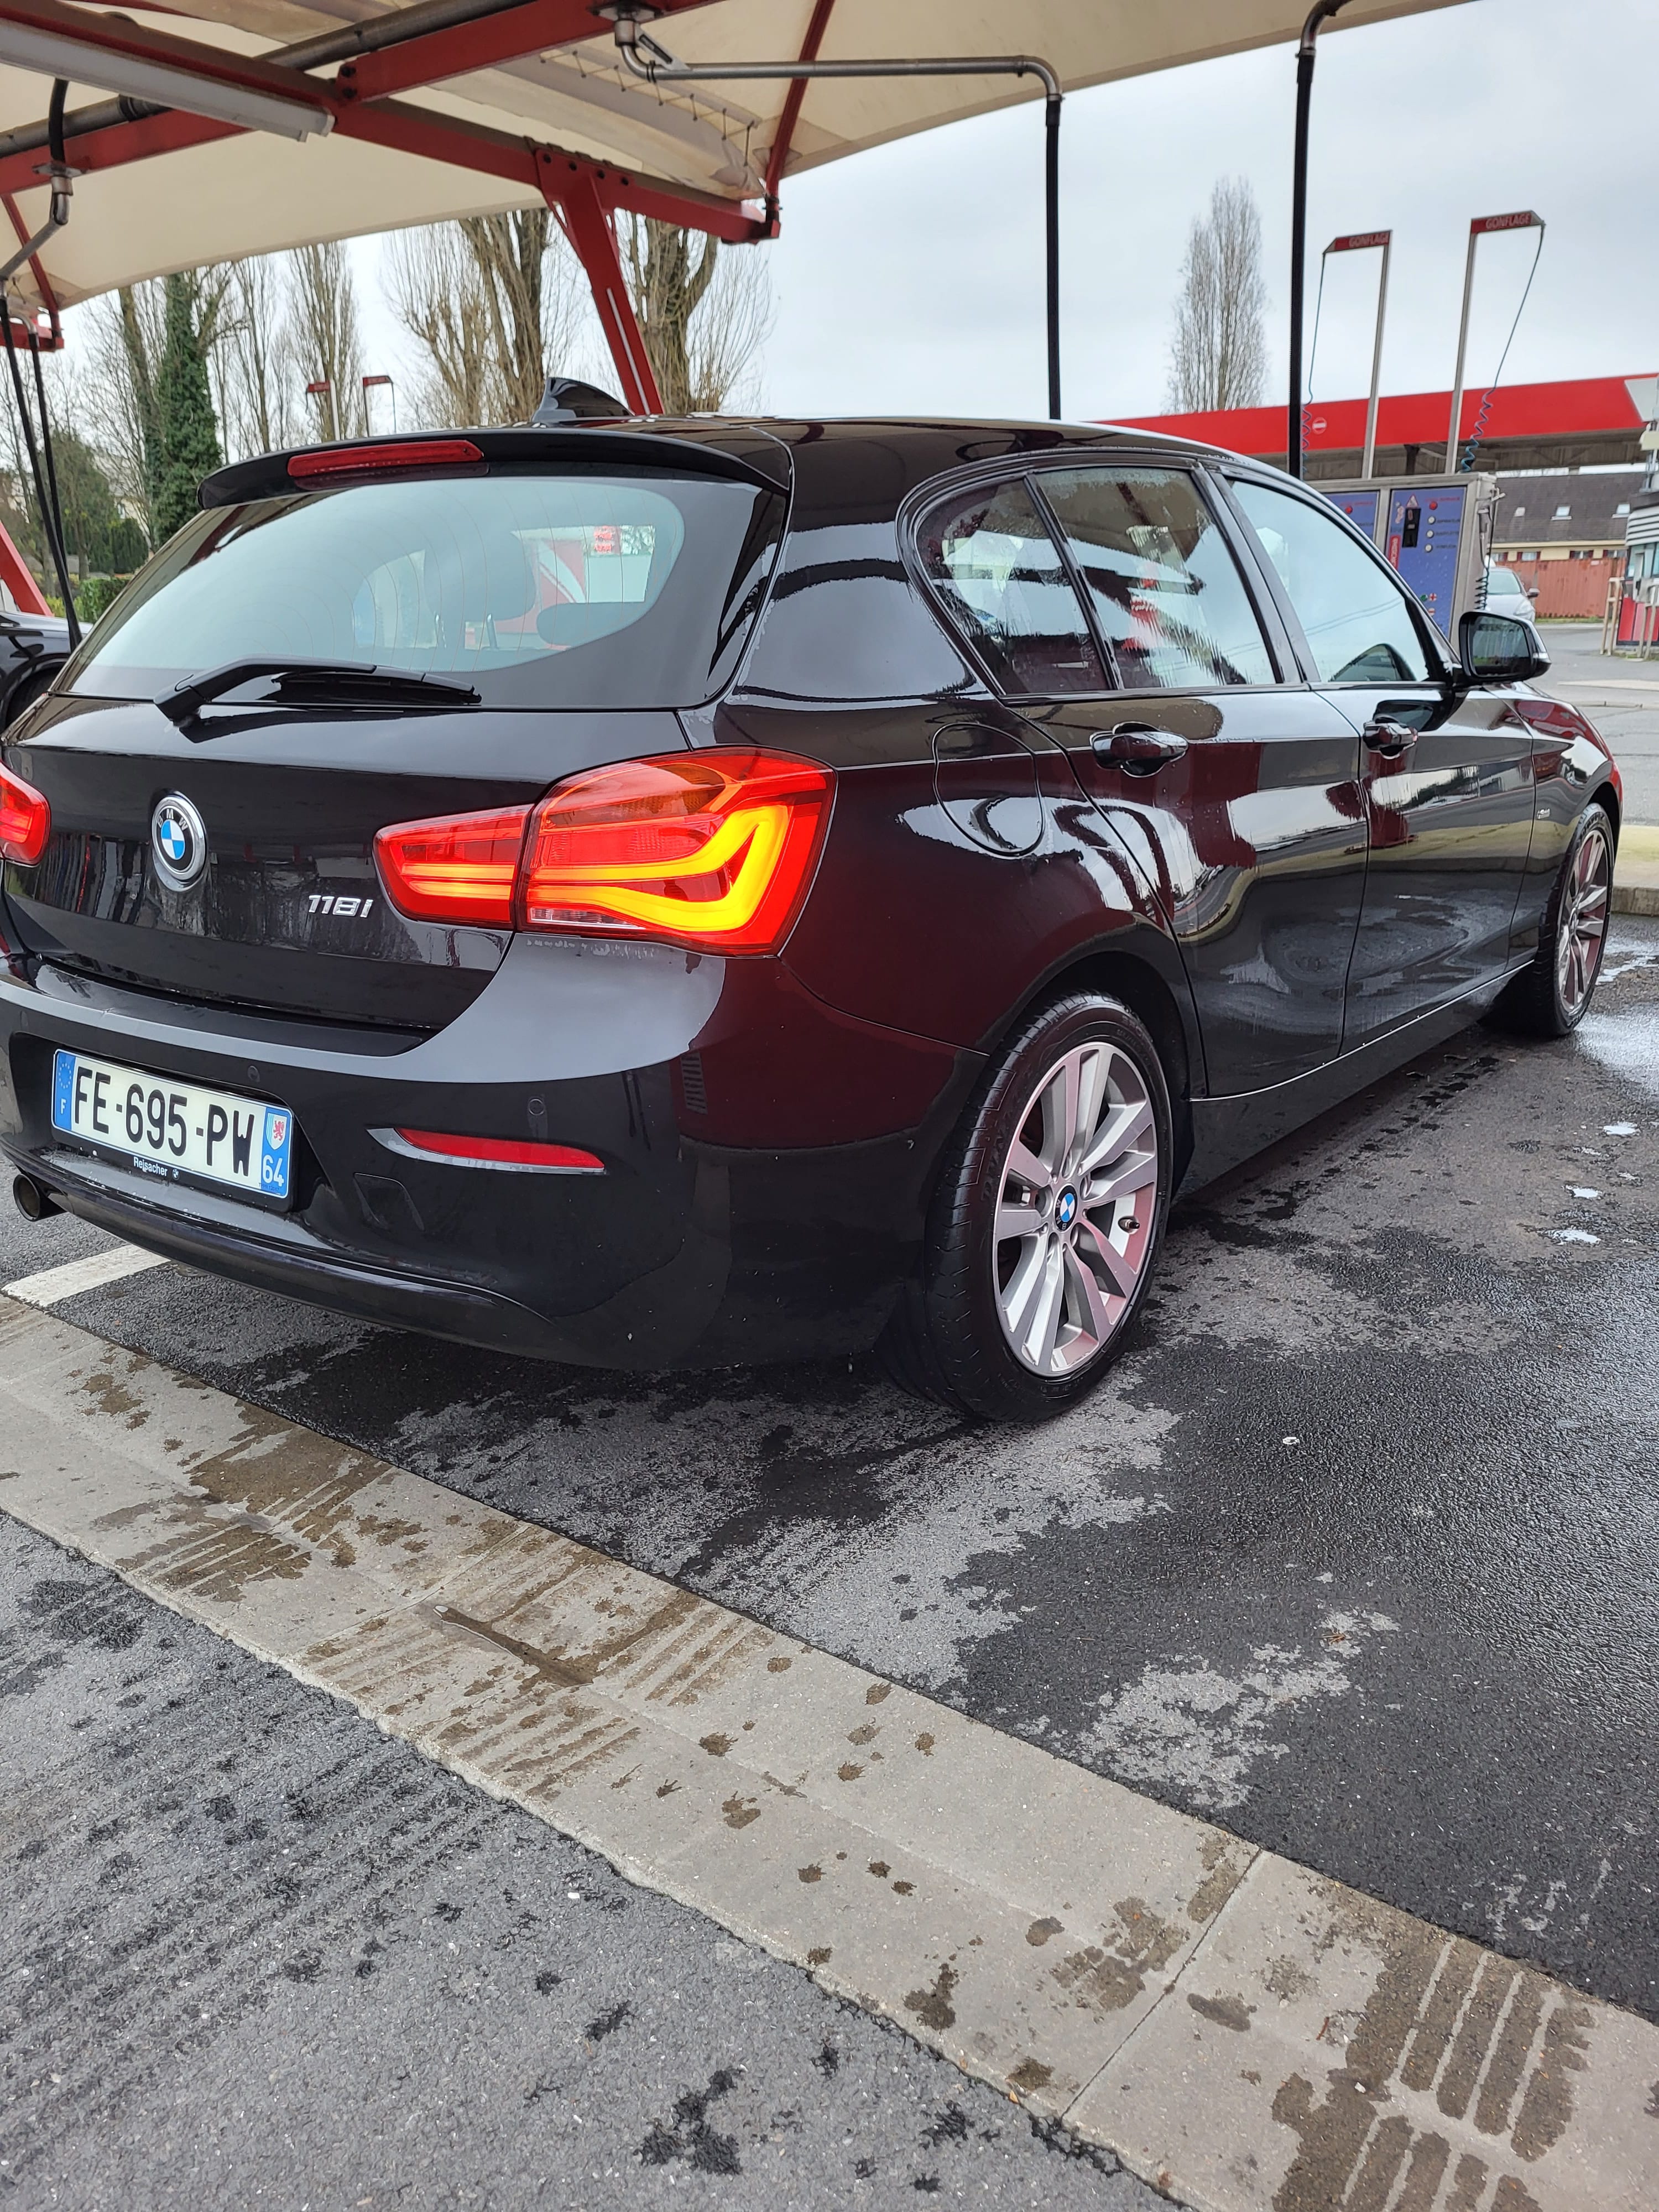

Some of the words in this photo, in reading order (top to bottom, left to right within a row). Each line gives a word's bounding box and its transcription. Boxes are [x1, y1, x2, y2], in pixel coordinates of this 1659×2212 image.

[1485, 213, 1530, 230] GONFLAGE
[157, 808, 189, 831] BMW
[60, 1098, 67, 1114] F
[75, 1066, 255, 1177] FE-695-PW
[133, 1156, 168, 1177] Reisacher
[263, 1154, 284, 1187] 64
